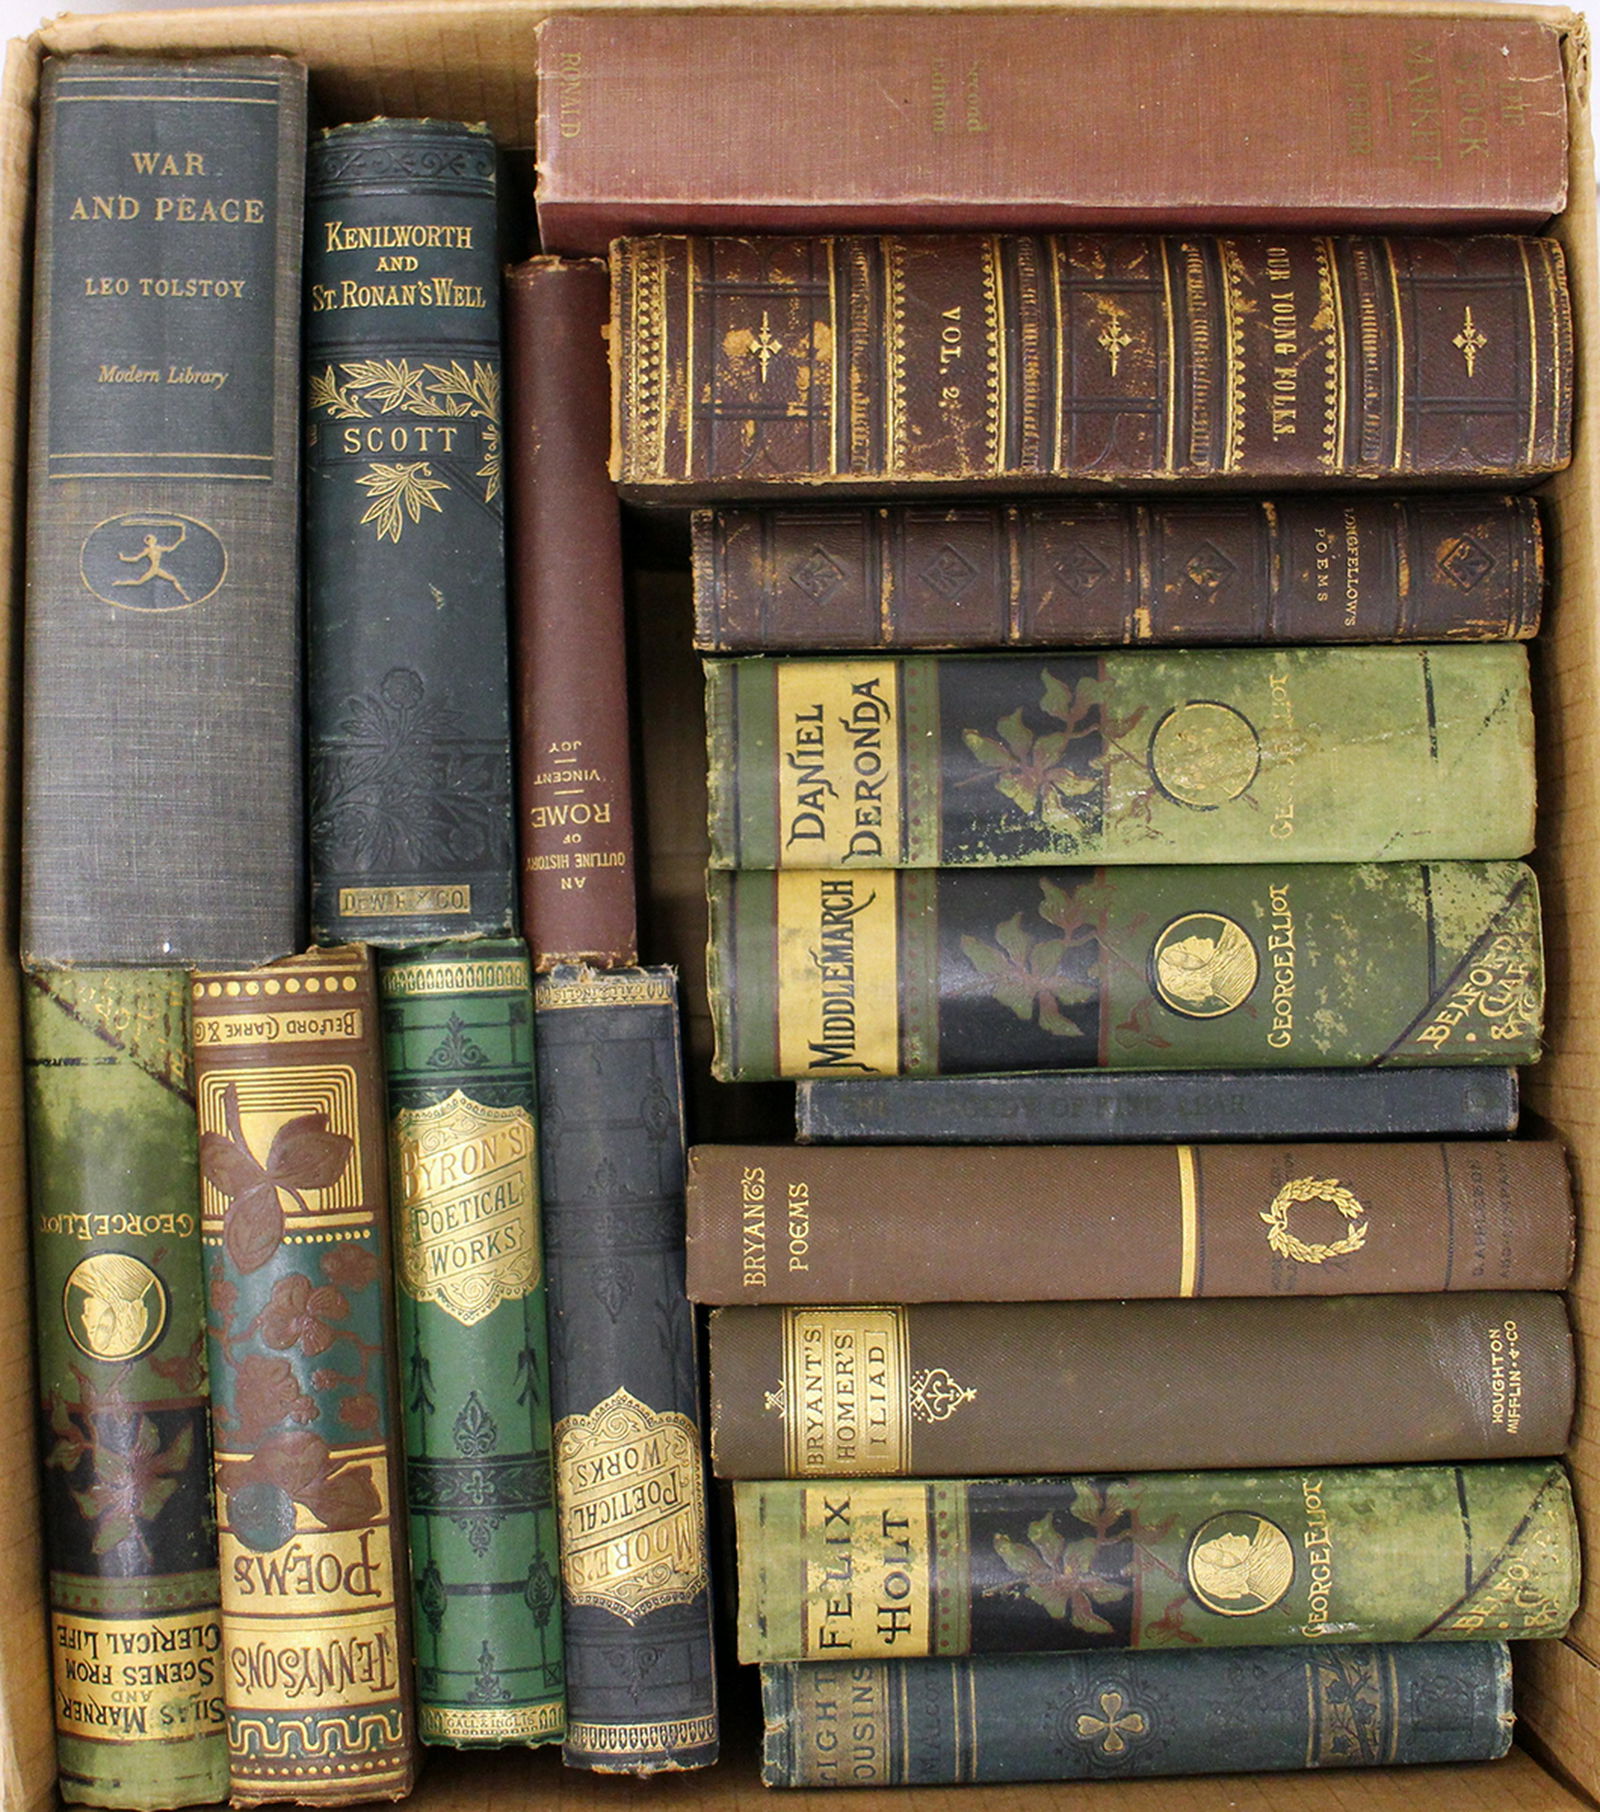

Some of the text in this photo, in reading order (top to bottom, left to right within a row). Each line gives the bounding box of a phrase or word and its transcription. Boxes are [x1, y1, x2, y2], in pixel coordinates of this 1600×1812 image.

[559, 52, 582, 139] RONALD
[1404, 39, 1443, 170] MARKET
[1452, 52, 1490, 158] STOCK
[133, 152, 207, 177] WAR
[70, 195, 265, 225] AND PEACE
[324, 221, 474, 252] KENILWORTH
[85, 278, 246, 298] LEO TOLSTOY
[340, 280, 432, 309] RONAN'S
[431, 277, 486, 309] WELL
[375, 256, 419, 272] AND
[939, 306, 963, 375] VOL.
[1265, 246, 1298, 442] OUR YOUNG FOLKS.
[98, 364, 229, 390] Modern Library
[343, 427, 458, 454] SCOTT
[1314, 526, 1329, 602] POEMS
[1344, 507, 1360, 628] LONGFELLOW'S
[534, 769, 601, 785] VINCENT
[549, 741, 582, 753] JOY
[786, 704, 840, 849] DANIEL
[841, 677, 891, 863] DERONDA
[530, 803, 611, 828] ROME
[563, 833, 582, 844] OF
[525, 852, 626, 871] OUTLINE HISTORY
[560, 876, 587, 891] AN
[808, 879, 881, 1073] MIDDLEMARCH
[1267, 884, 1296, 1048] GEORGE ELIOT
[207, 1021, 222, 1043] &
[225, 1014, 280, 1040] CLARKE
[286, 1011, 357, 1036] BELFORD
[401, 1125, 525, 1201] BYRON'S
[39, 1212, 195, 1240] GEORGE ELIOT
[413, 1182, 521, 1243] POETICAL
[741, 1166, 766, 1287] BRYANT'S
[788, 1182, 809, 1272] POEMS
[431, 1223, 517, 1277] WORKS
[803, 1326, 825, 1467] BRYANT'S
[834, 1333, 856, 1462] HOMER'S
[869, 1346, 886, 1446] ILIAD
[1489, 1328, 1505, 1424] HOUGHTON
[577, 1437, 661, 1488] WORKS
[573, 1472, 679, 1532] POETICAL
[232, 1528, 383, 1598] POEMS
[571, 1510, 694, 1587] MOORE'S
[819, 1495, 853, 1649] FELIX
[876, 1508, 912, 1645] HOLT
[1301, 1479, 1333, 1639] GEORGE ELIOT
[57, 1622, 221, 1660] CLERICAL LIFE
[231, 1626, 398, 1698] TENNYSON'S
[65, 1656, 215, 1687] SCENES FROM
[111, 1690, 153, 1703] AND
[57, 1685, 148, 1735] MARNER
[446, 1718, 478, 1728] GALL
[491, 1715, 536, 1729] INGLIS
[853, 1661, 876, 1782] OUSINS
